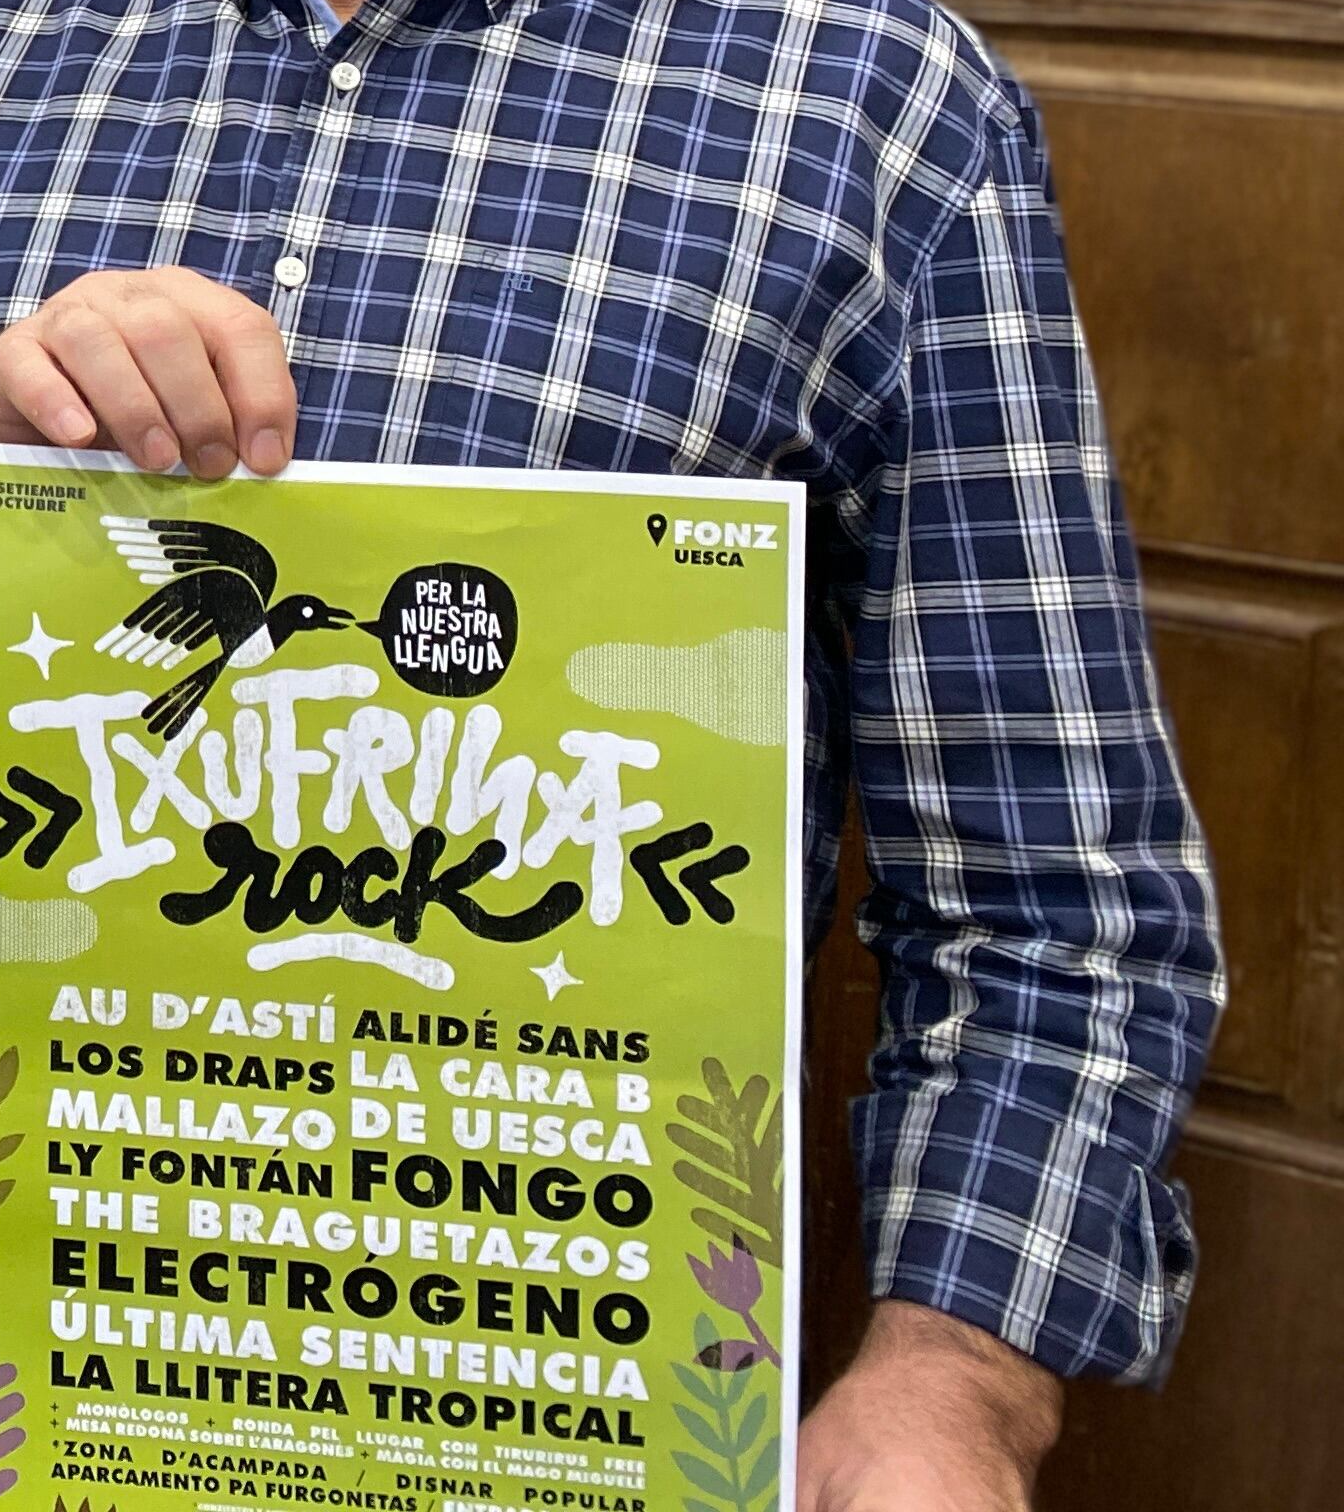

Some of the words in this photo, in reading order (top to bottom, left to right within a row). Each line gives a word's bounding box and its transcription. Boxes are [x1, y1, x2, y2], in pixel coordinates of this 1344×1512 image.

[674, 520, 778, 550] FONZ
[674, 549, 744, 567] UESCA
[416, 579, 452, 605] PER
[462, 581, 486, 607] LA
[401, 605, 502, 639] NUESTRA
[394, 634, 504, 675] LLENGUA
[50, 986, 126, 1026] AU
[153, 993, 335, 1042] D'ASTÍ
[353, 1010, 497, 1050] ALIDÉ
[518, 1024, 649, 1063] SANS
[51, 1040, 143, 1078] LOS
[166, 1049, 334, 1094] DRAPS
[351, 1050, 419, 1092] LA
[440, 1058, 593, 1108] CARA
[617, 1073, 650, 1112] B
[48, 1088, 335, 1150] MALLAZO
[351, 1097, 426, 1144] DE
[452, 1107, 651, 1166] UESCA
[49, 1141, 102, 1176] LY
[123, 1148, 332, 1198] FONTÁN
[352, 1150, 652, 1227] FONGO
[50, 1187, 159, 1233] THE
[189, 1199, 650, 1281] BRAGUETAZOS
[53, 1238, 649, 1345] ELECTRÓGENO
[51, 1289, 277, 1360] ÚLTIMA
[300, 1325, 649, 1400] SENTENCIA
[52, 1351, 114, 1391] LA
[136, 1359, 348, 1415] LLITERA
[369, 1383, 645, 1447] TROPICAL
[65, 1417, 111, 1434] MESA
[115, 1421, 186, 1442] REDONA
[190, 1429, 244, 1448] SOBRE
[232, 1417, 295, 1437] RONDA
[310, 1426, 340, 1441] PEL
[356, 1430, 424, 1450] LLUGAR
[440, 1439, 478, 1456] CON
[51, 1462, 221, 1493] APARCAMENTO
[229, 1478, 258, 1498] PA
[266, 1482, 419, 1512] FURGONETAS
[162, 1449, 327, 1481] D'ACAMPADA
[396, 1473, 494, 1499] DISNAR
[524, 1487, 646, 1512] POPULAR
[440, 1455, 478, 1472] CON
[483, 1460, 503, 1475] EL
[506, 1463, 561, 1481] MAGO
